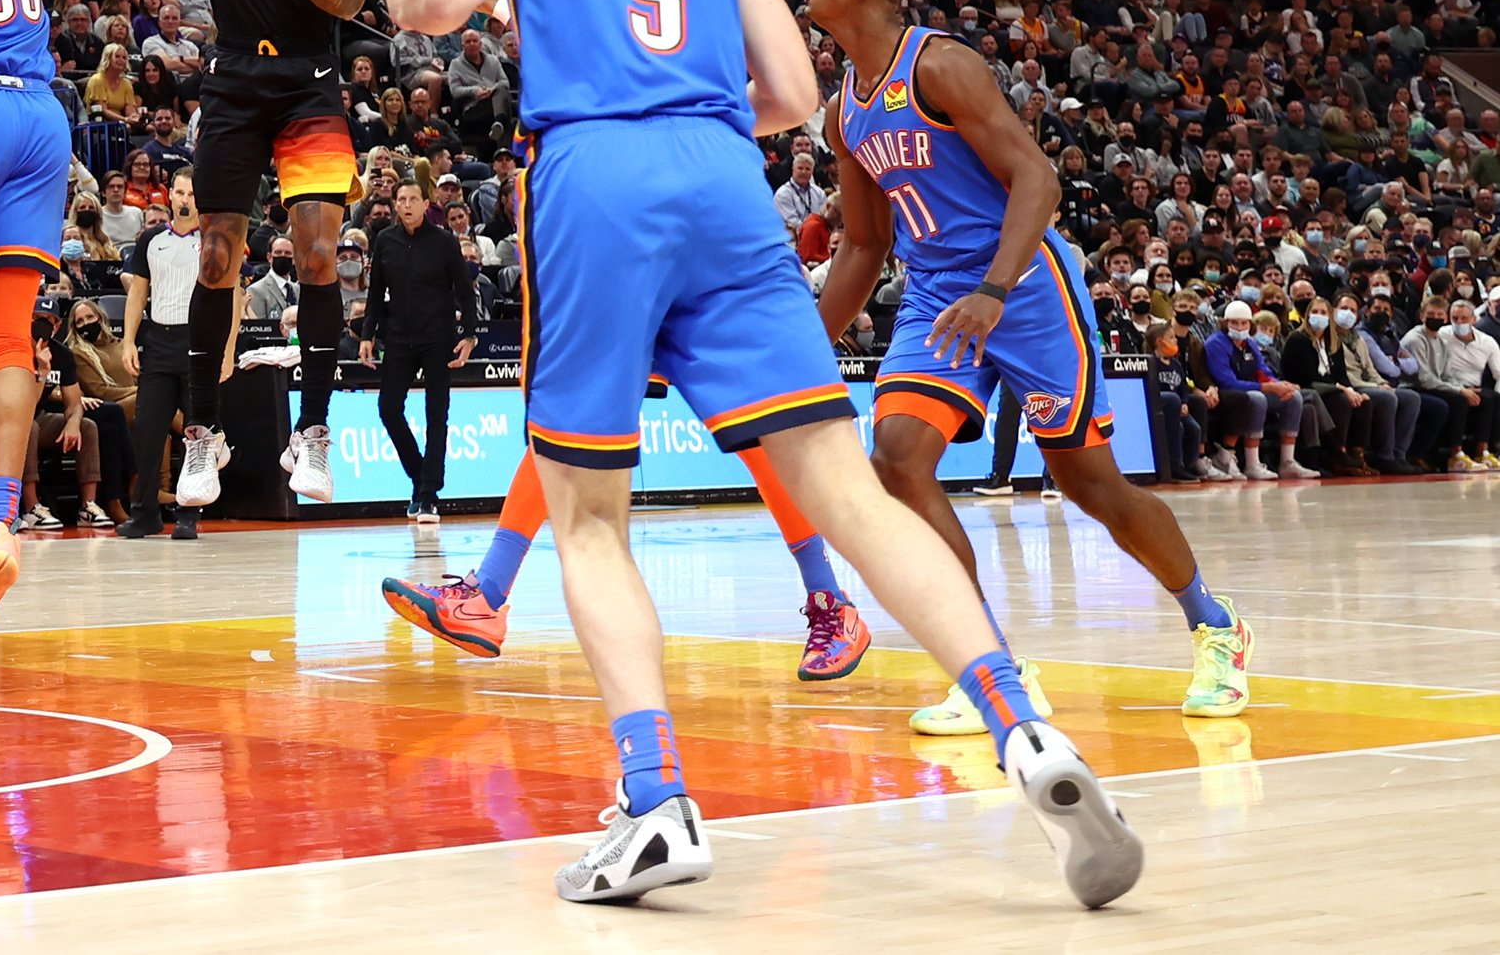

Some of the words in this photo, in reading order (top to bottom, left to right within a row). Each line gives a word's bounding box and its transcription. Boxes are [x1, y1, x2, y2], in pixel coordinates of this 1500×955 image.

[885, 181, 939, 242] 11
[1122, 358, 1148, 371] vivint
[1029, 398, 1051, 415] OKC
[478, 414, 508, 436] XM
